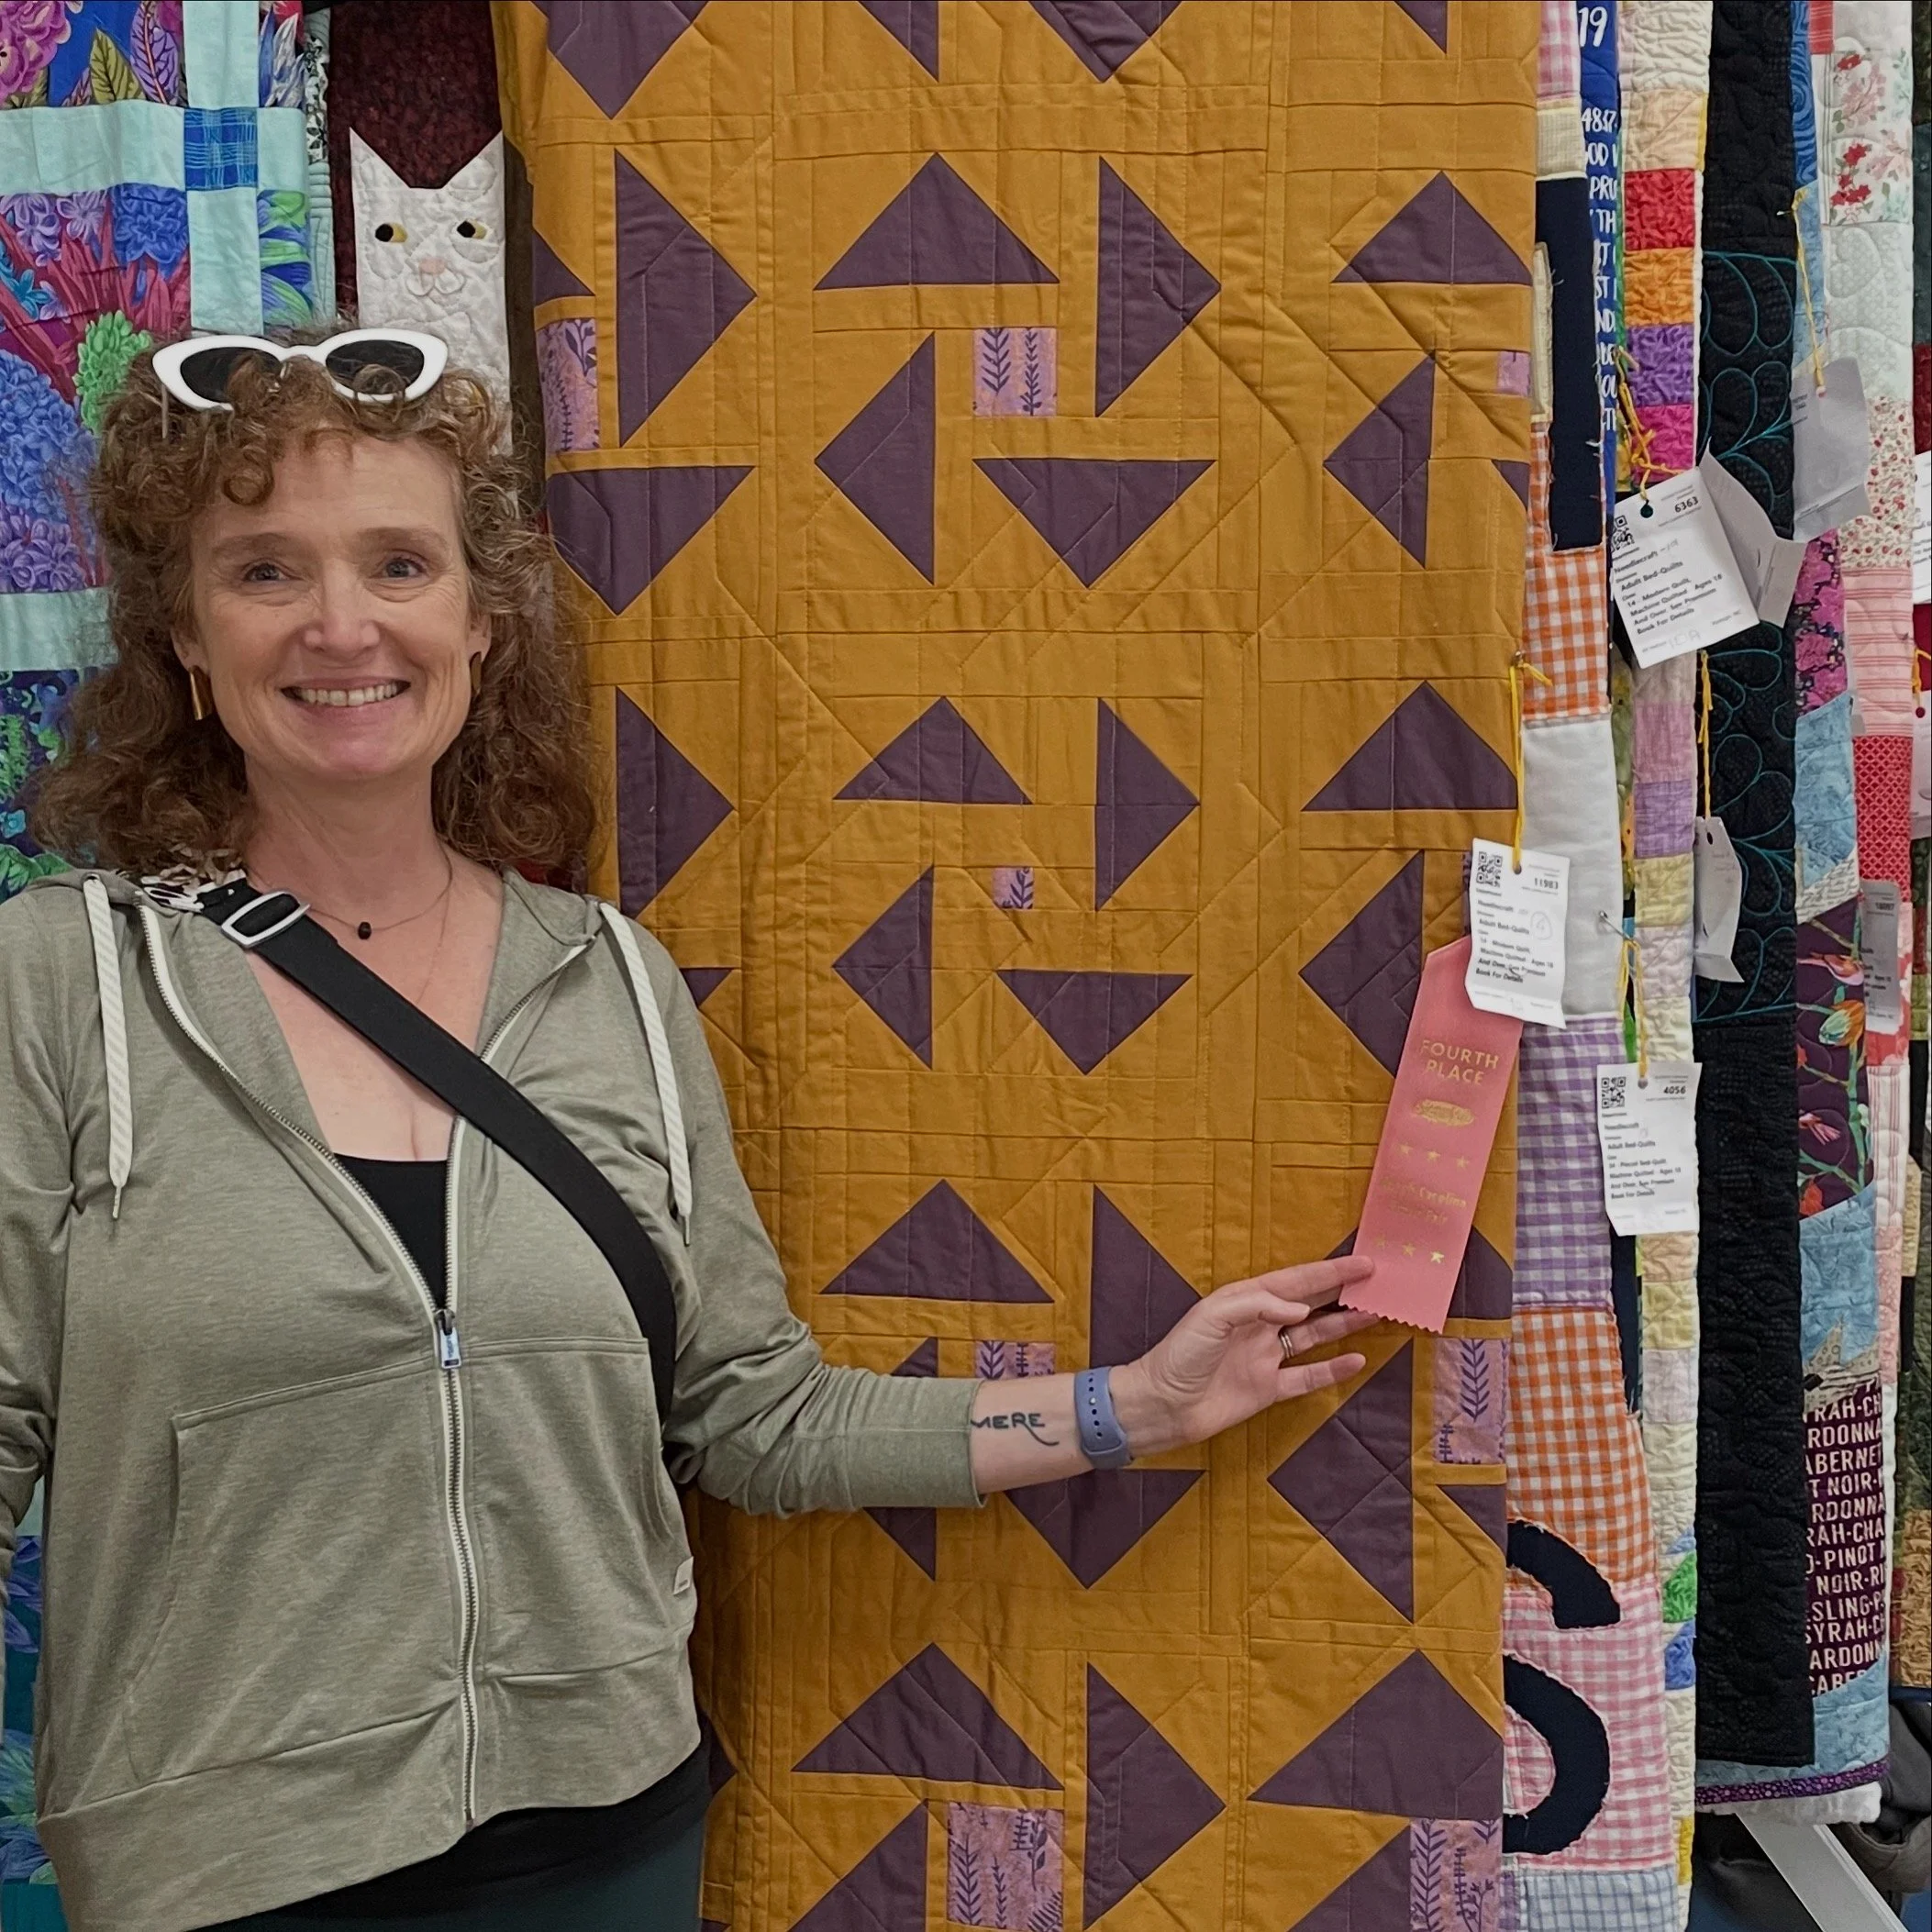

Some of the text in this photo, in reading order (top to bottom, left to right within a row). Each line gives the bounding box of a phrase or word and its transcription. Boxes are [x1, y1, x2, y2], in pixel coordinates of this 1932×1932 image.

[1578, 6, 1607, 47] 19
[1674, 497, 1699, 514] 6363
[1422, 1039, 1500, 1069] FOURTH
[1424, 1060, 1485, 1086] PLACE
[1663, 1085, 1686, 1094] 4056
